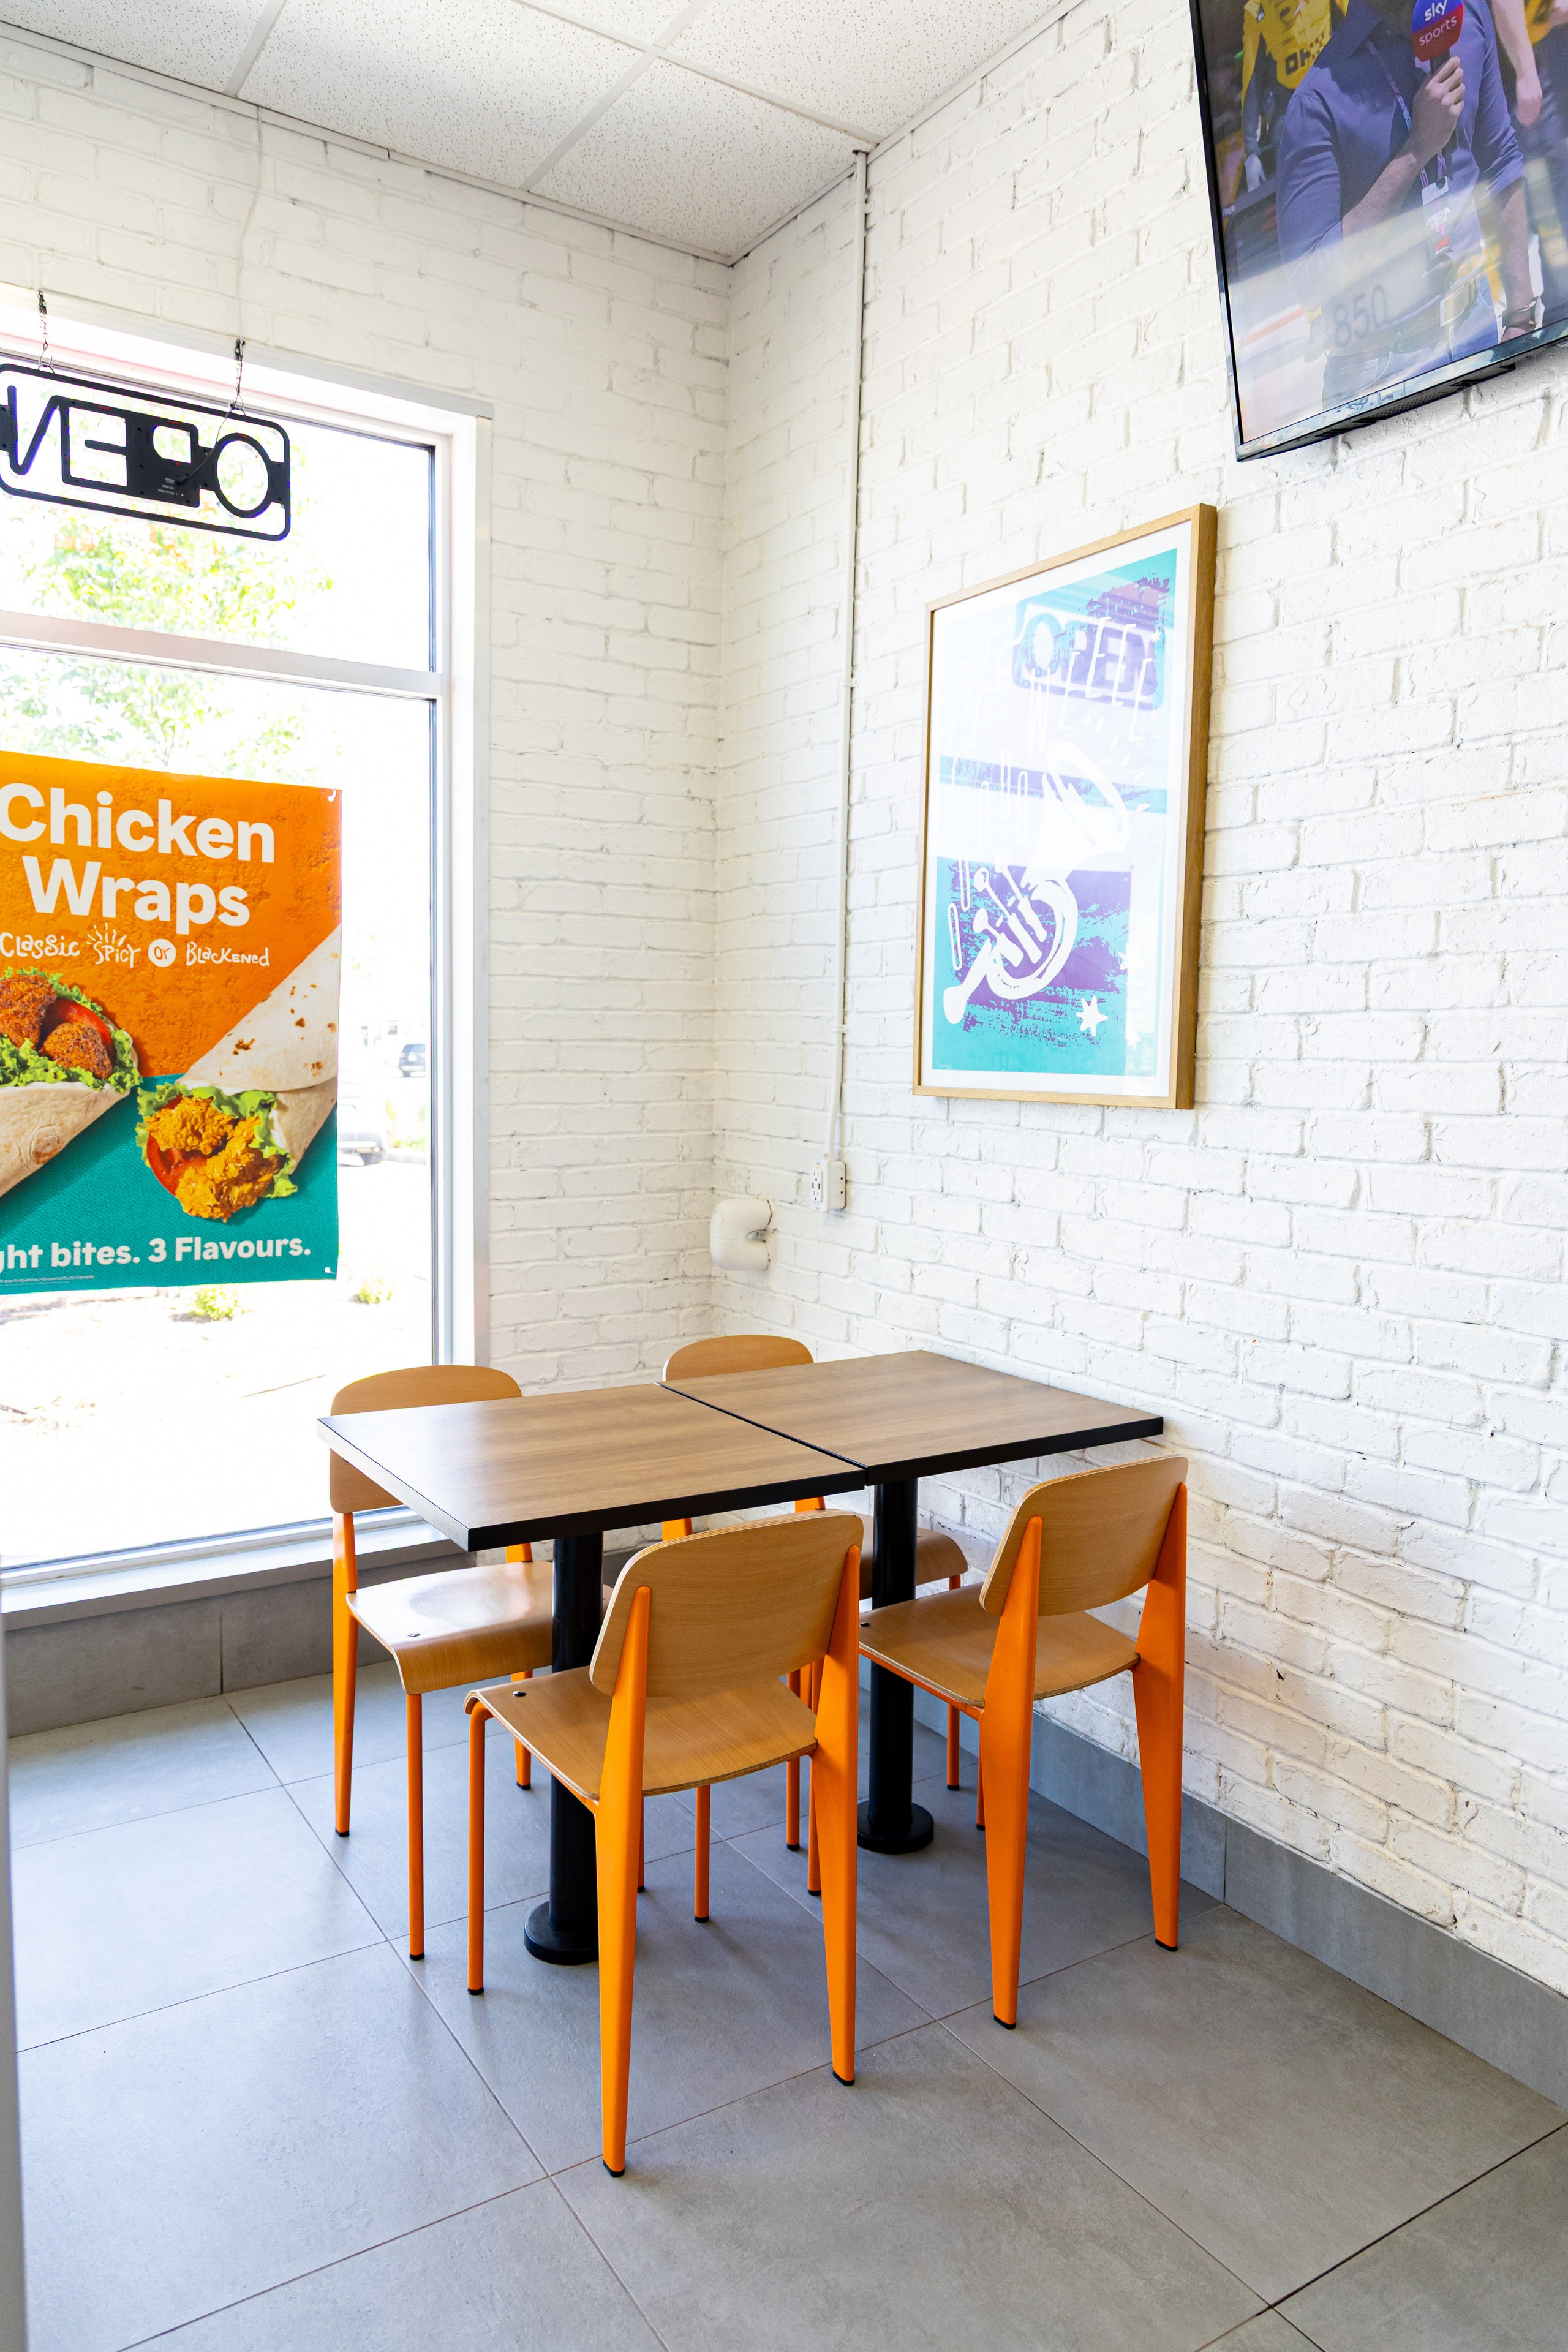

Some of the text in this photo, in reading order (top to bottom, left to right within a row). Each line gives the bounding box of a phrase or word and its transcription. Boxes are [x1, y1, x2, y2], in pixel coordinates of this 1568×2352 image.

[1424, 0, 1447, 21] sky
[1419, 16, 1457, 46] sports
[0, 783, 274, 863] Chicken
[22, 855, 251, 935] Wraps
[51, 1240, 140, 1267] bites.
[148, 1238, 167, 1262] 3
[175, 1237, 311, 1261] Flavours.
